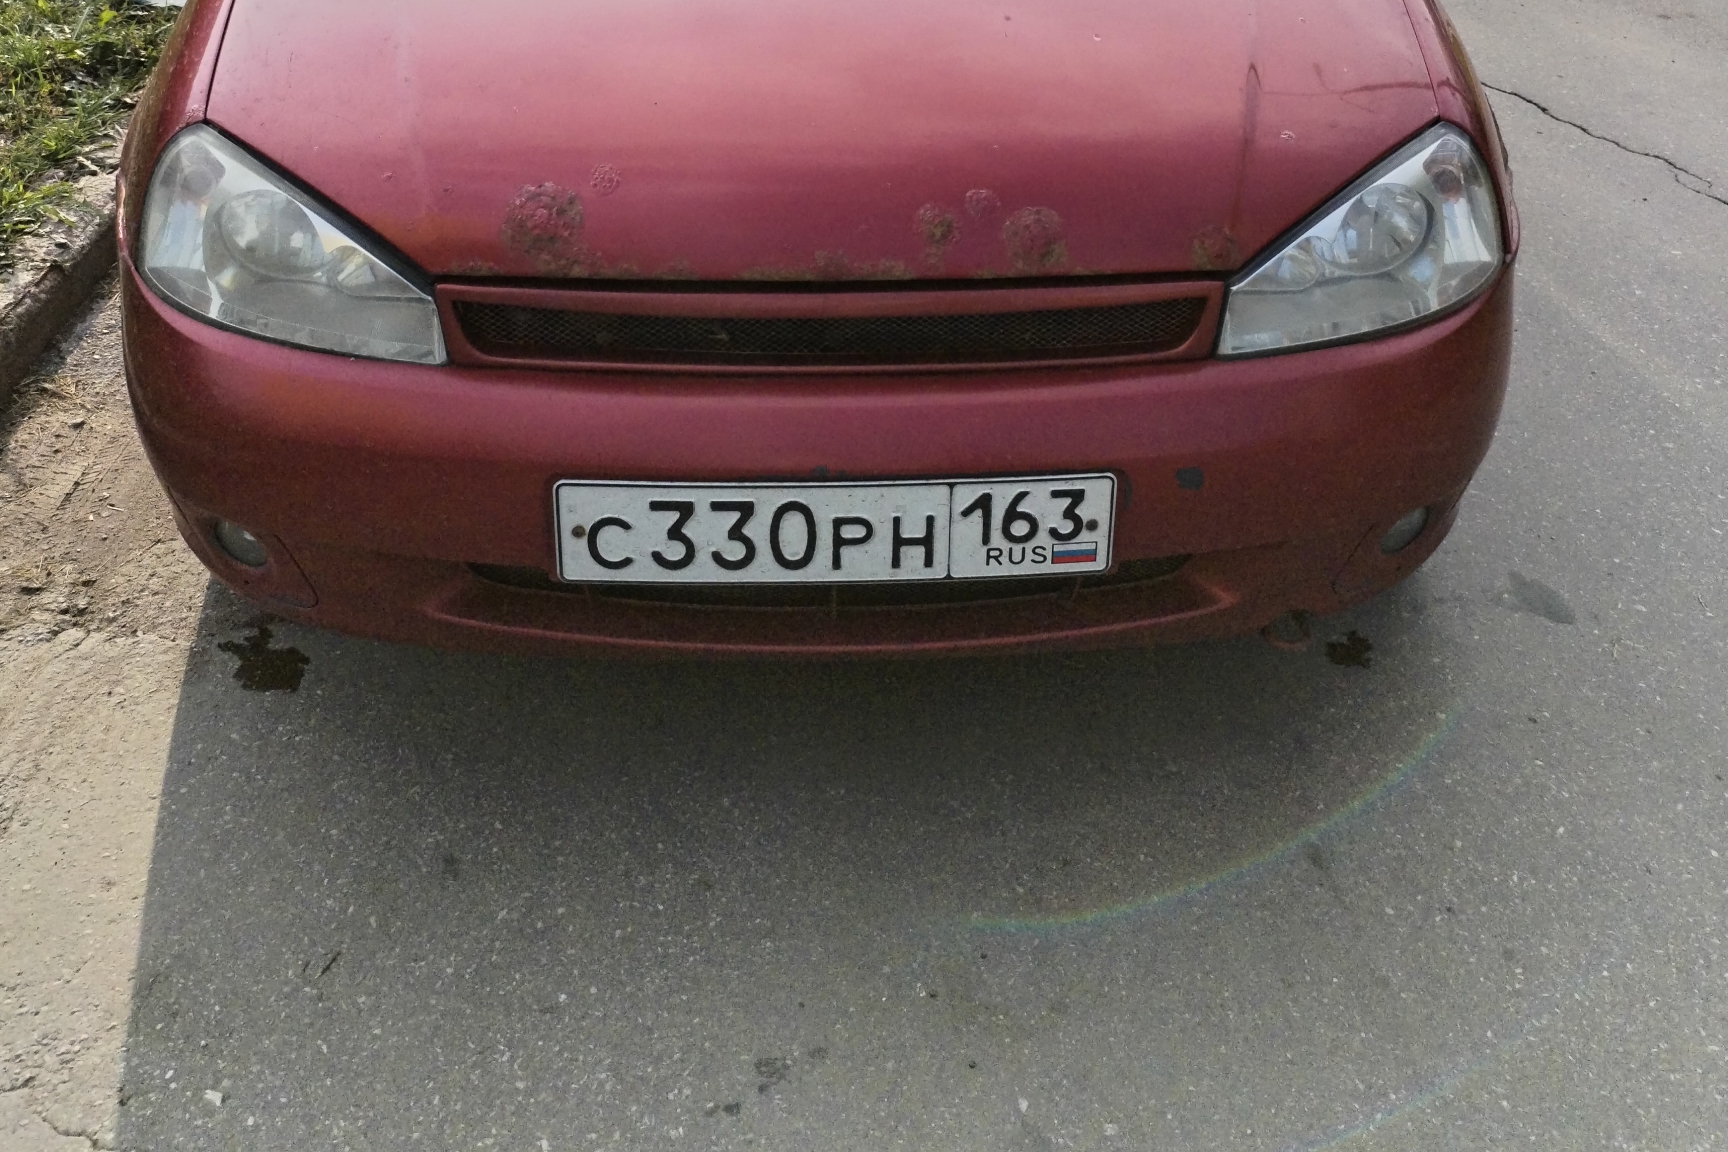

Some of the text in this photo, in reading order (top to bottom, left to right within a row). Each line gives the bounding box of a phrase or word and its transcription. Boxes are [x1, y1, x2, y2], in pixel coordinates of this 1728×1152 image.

[587, 488, 1084, 571] С330РН 163
[985, 545, 1048, 567] RUS
